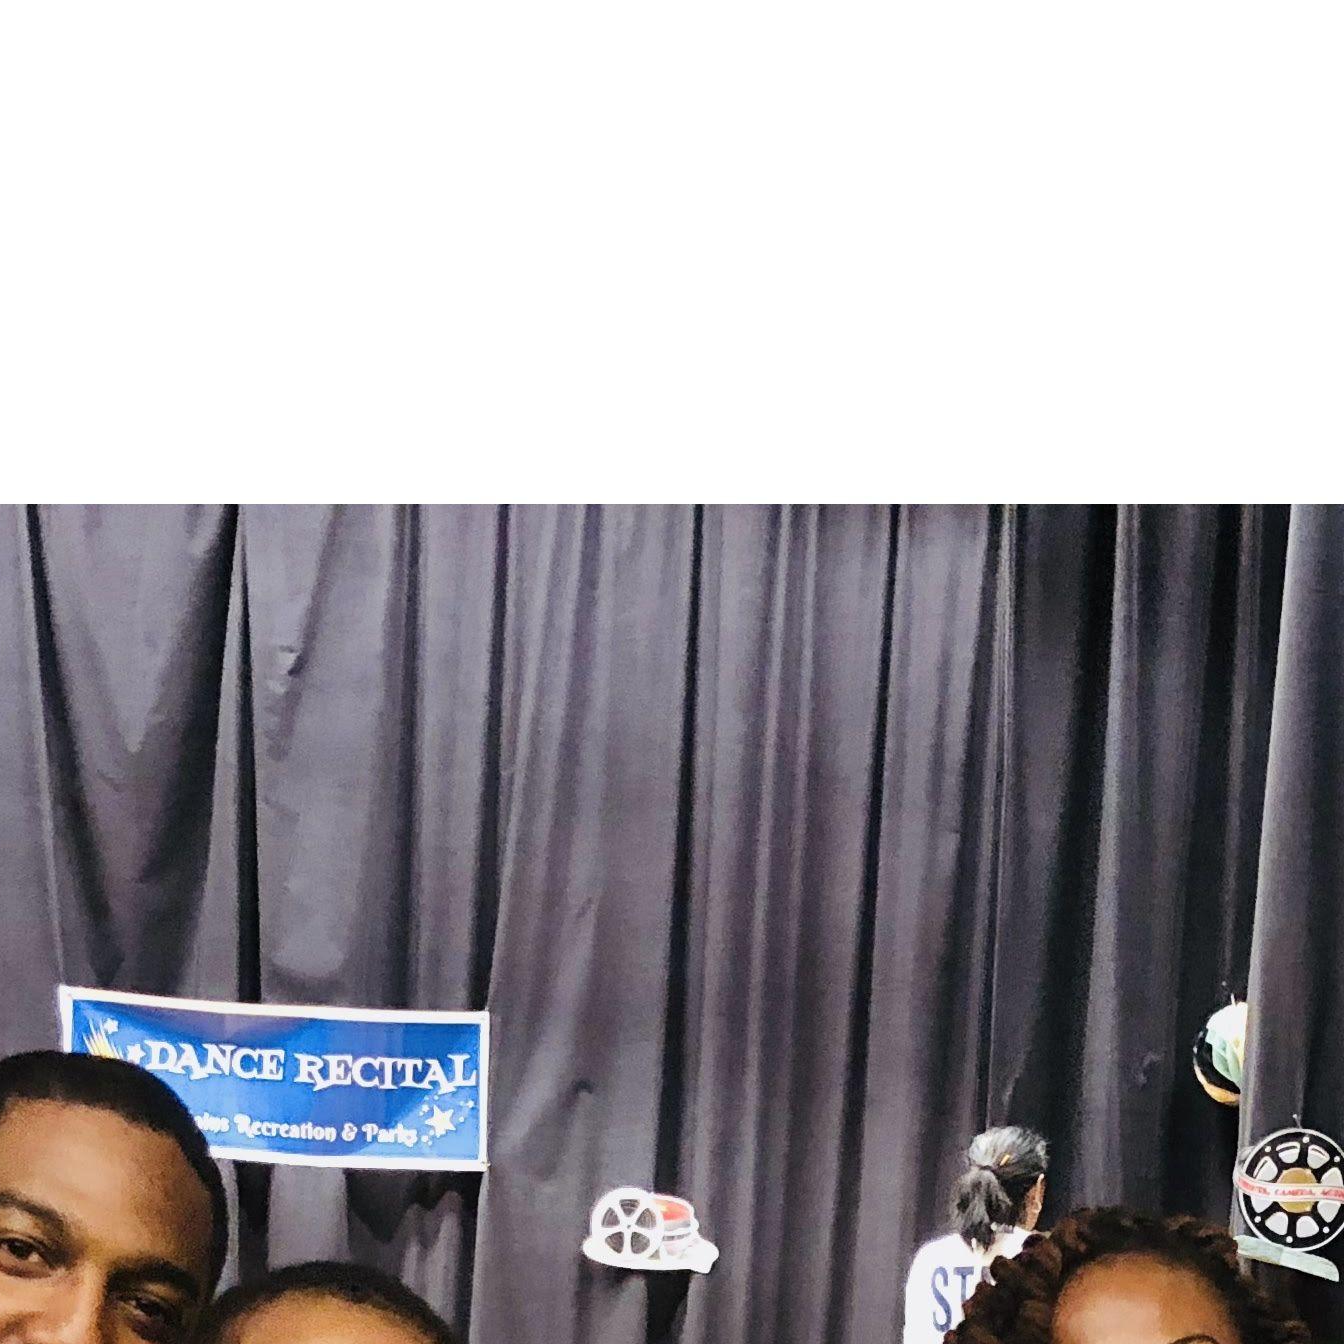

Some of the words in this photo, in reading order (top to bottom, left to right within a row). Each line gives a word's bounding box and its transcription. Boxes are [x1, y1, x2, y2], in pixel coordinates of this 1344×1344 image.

[144, 1040, 285, 1080] DANCE
[293, 1053, 477, 1095] RECITAL
[234, 1113, 337, 1142] Recreation
[342, 1123, 357, 1141] &
[362, 1123, 417, 1147] Parks
[931, 1266, 991, 1332] ST
